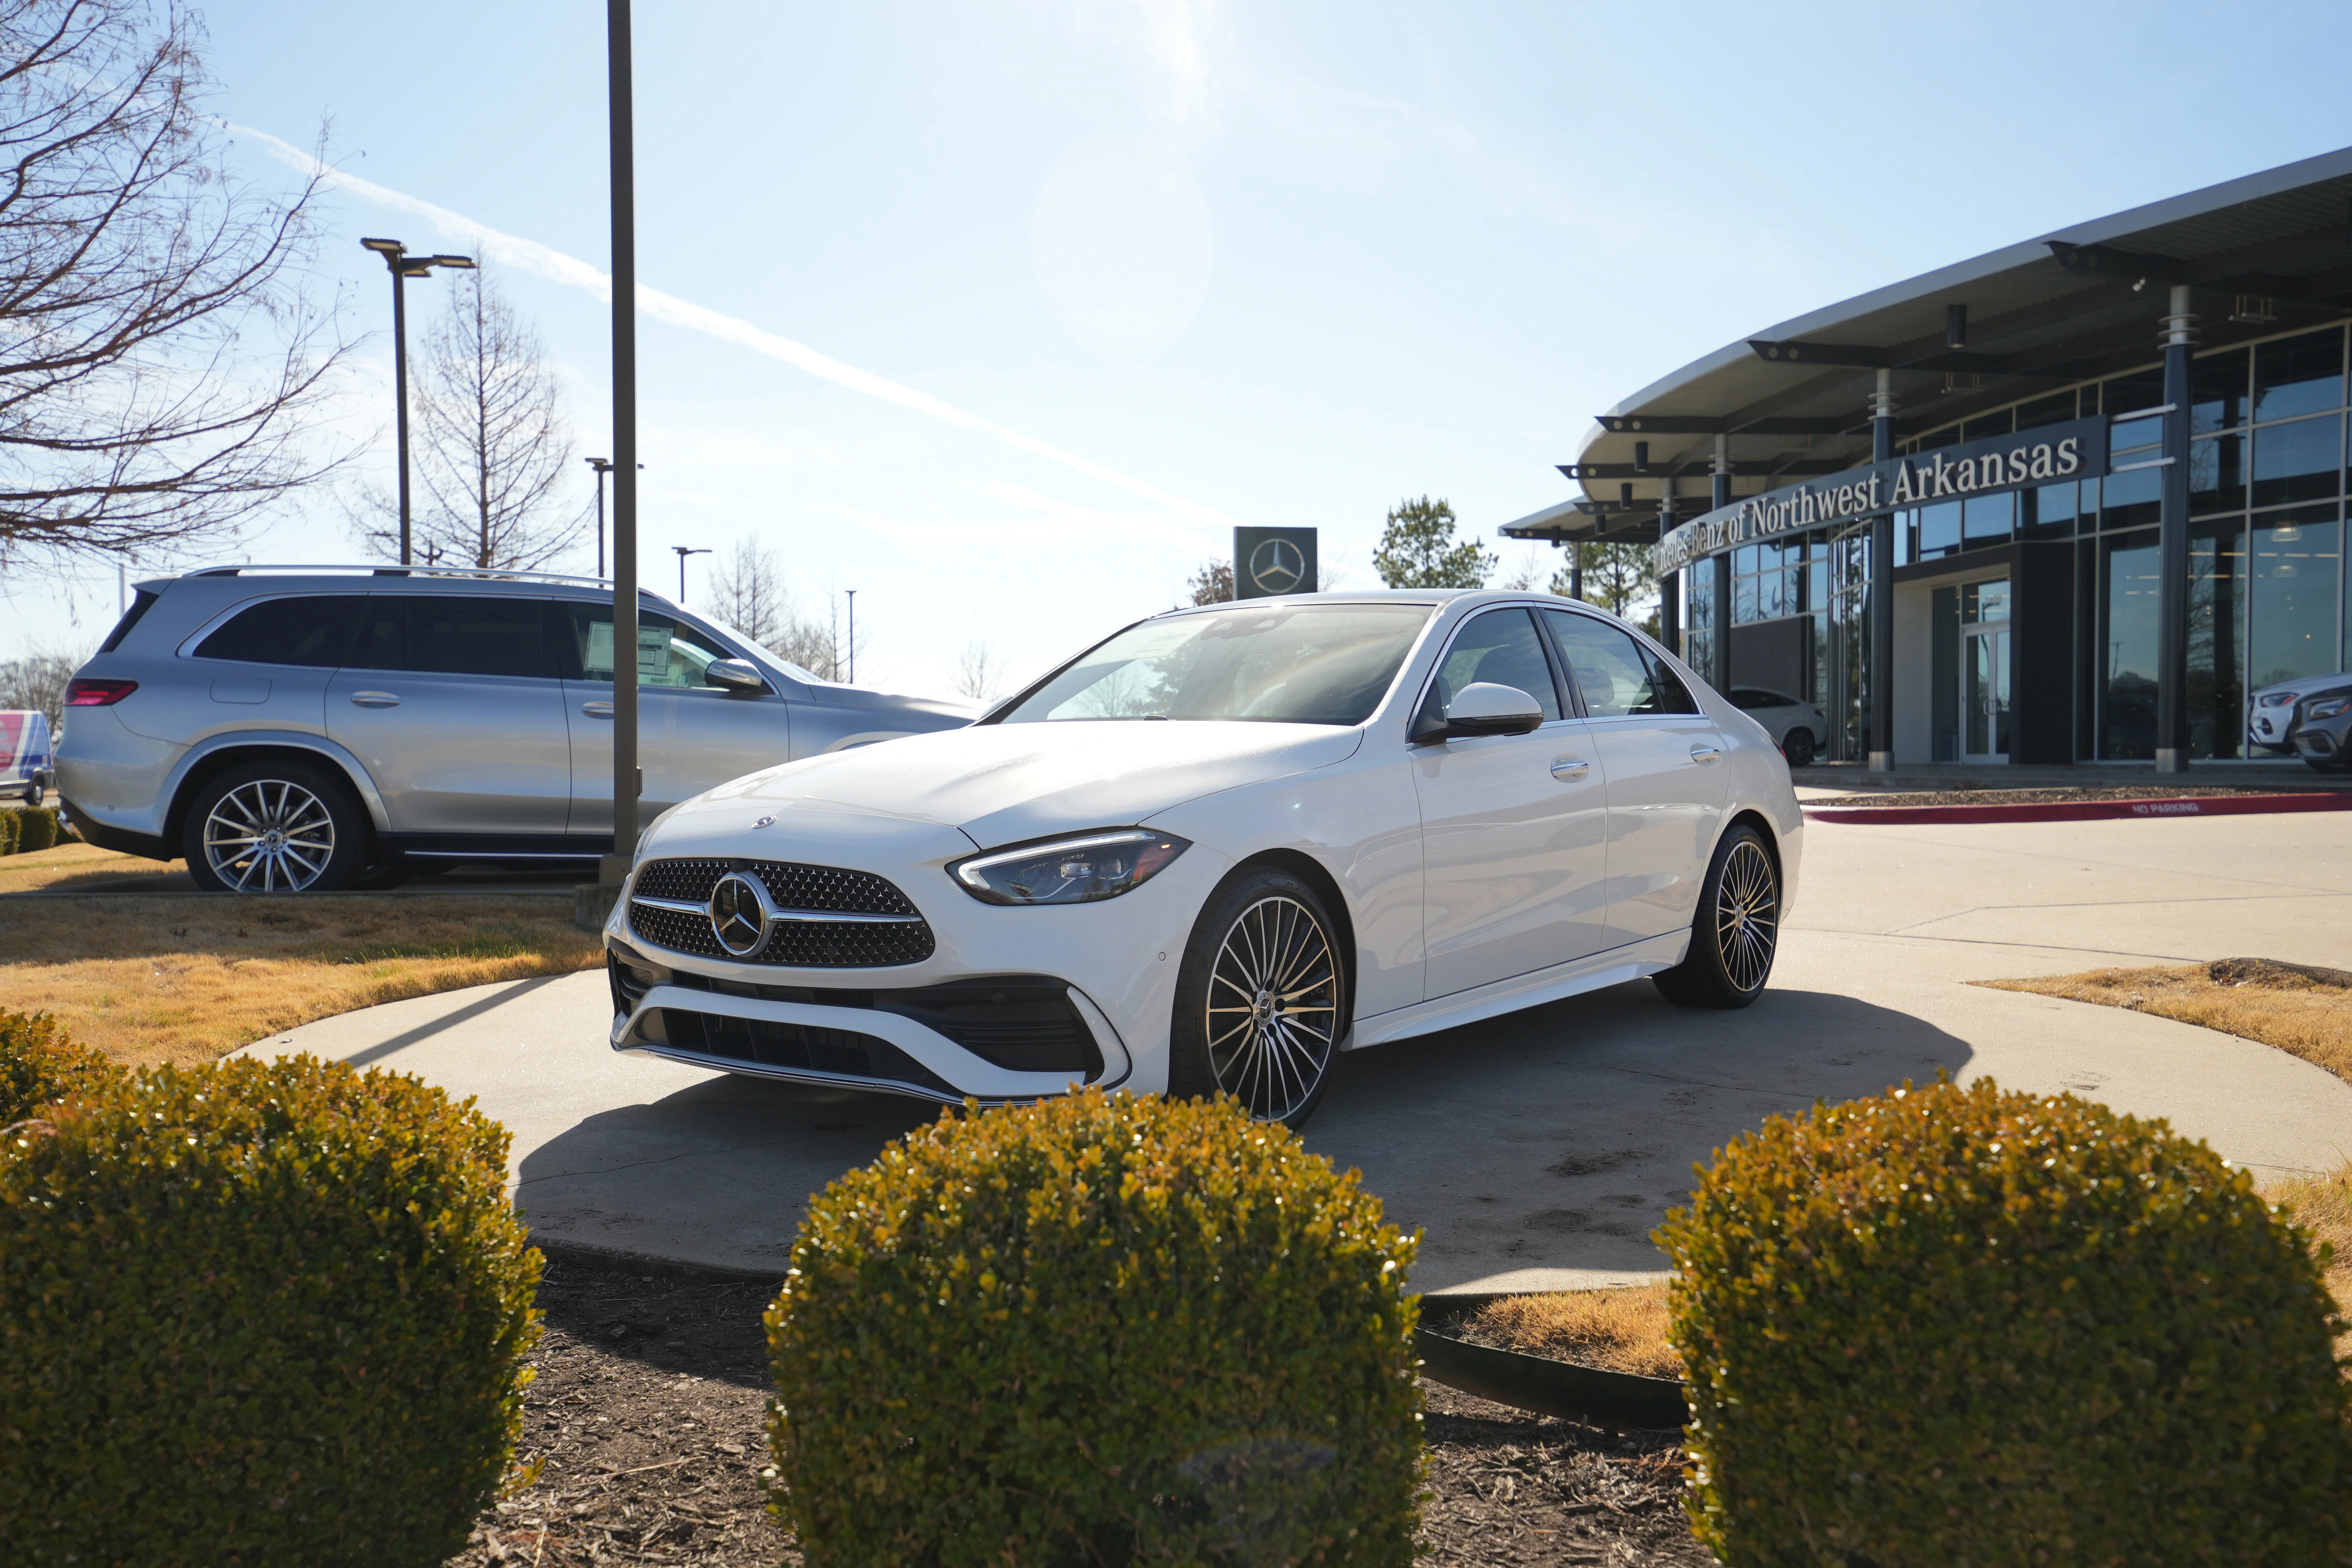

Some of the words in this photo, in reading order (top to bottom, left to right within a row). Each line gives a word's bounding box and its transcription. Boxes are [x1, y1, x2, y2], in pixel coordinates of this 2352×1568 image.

[1728, 503, 1746, 544] of
[1751, 471, 1880, 538] Northwest
[1890, 437, 2078, 506] Arkansas
[2132, 805, 2149, 814] NO
[2150, 803, 2199, 813] PARKING
